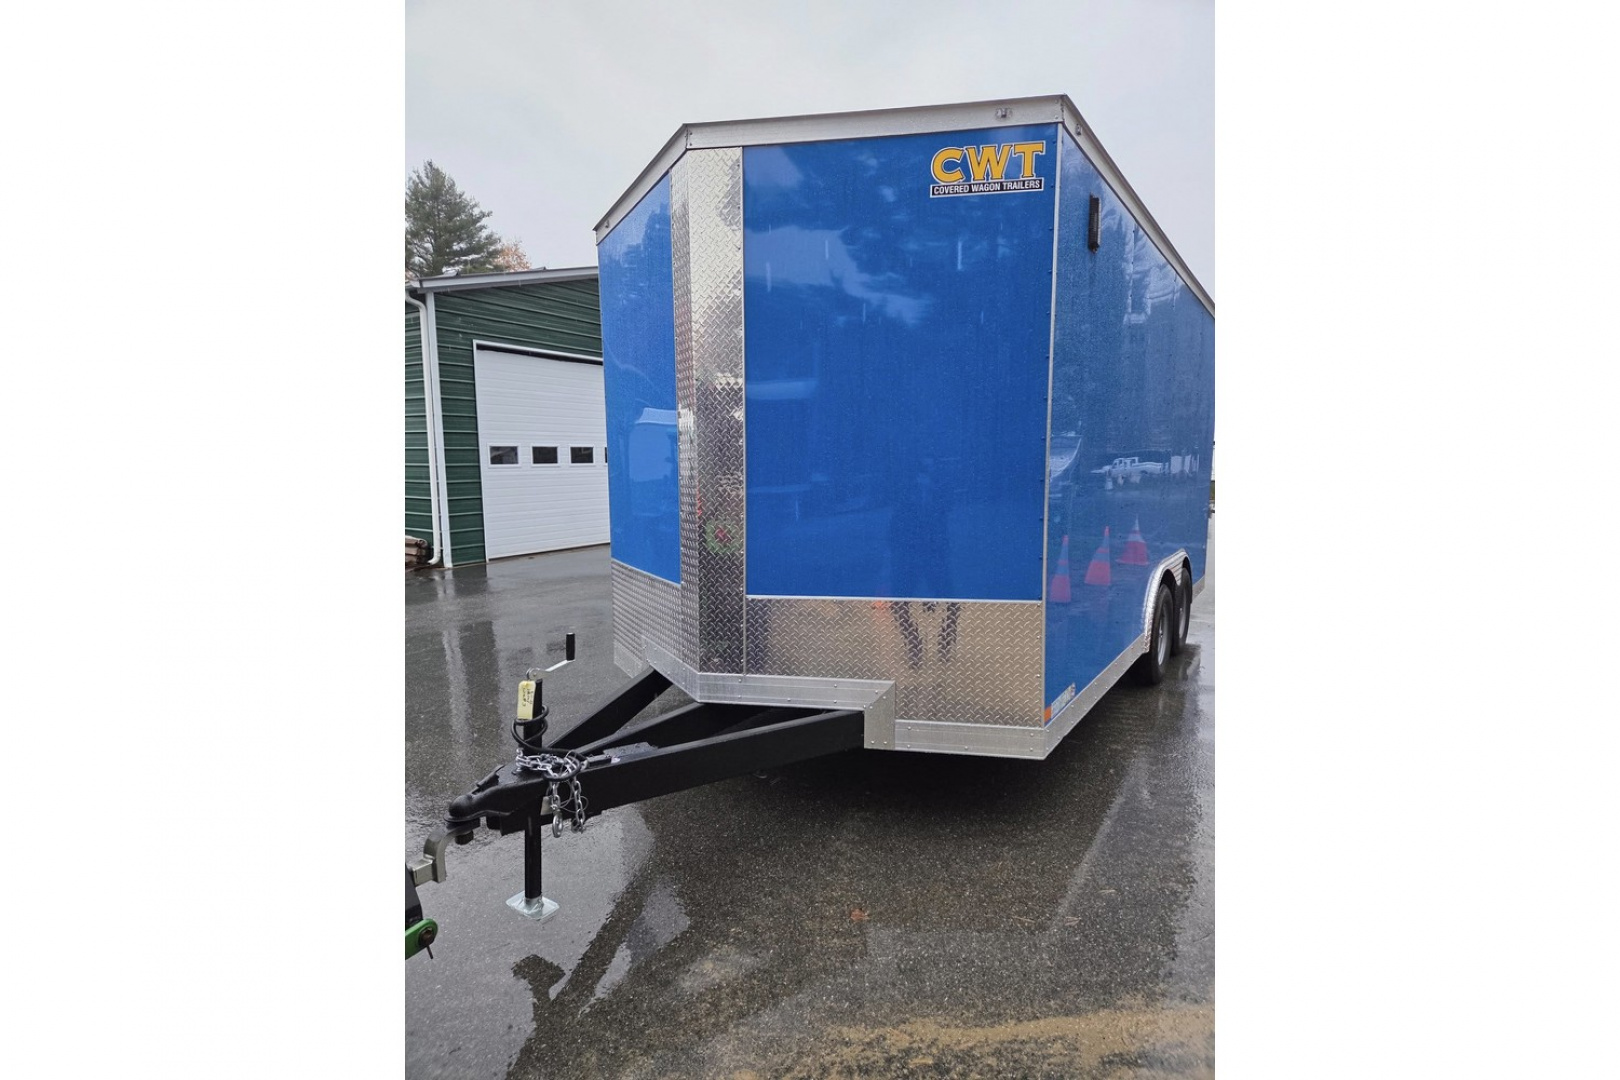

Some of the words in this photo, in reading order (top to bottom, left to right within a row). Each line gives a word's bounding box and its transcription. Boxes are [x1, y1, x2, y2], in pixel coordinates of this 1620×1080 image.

[931, 142, 1045, 183] CWT
[933, 185, 969, 194] COVERED
[971, 183, 1001, 192] WAGON
[1002, 180, 1040, 190] TRAILERS
